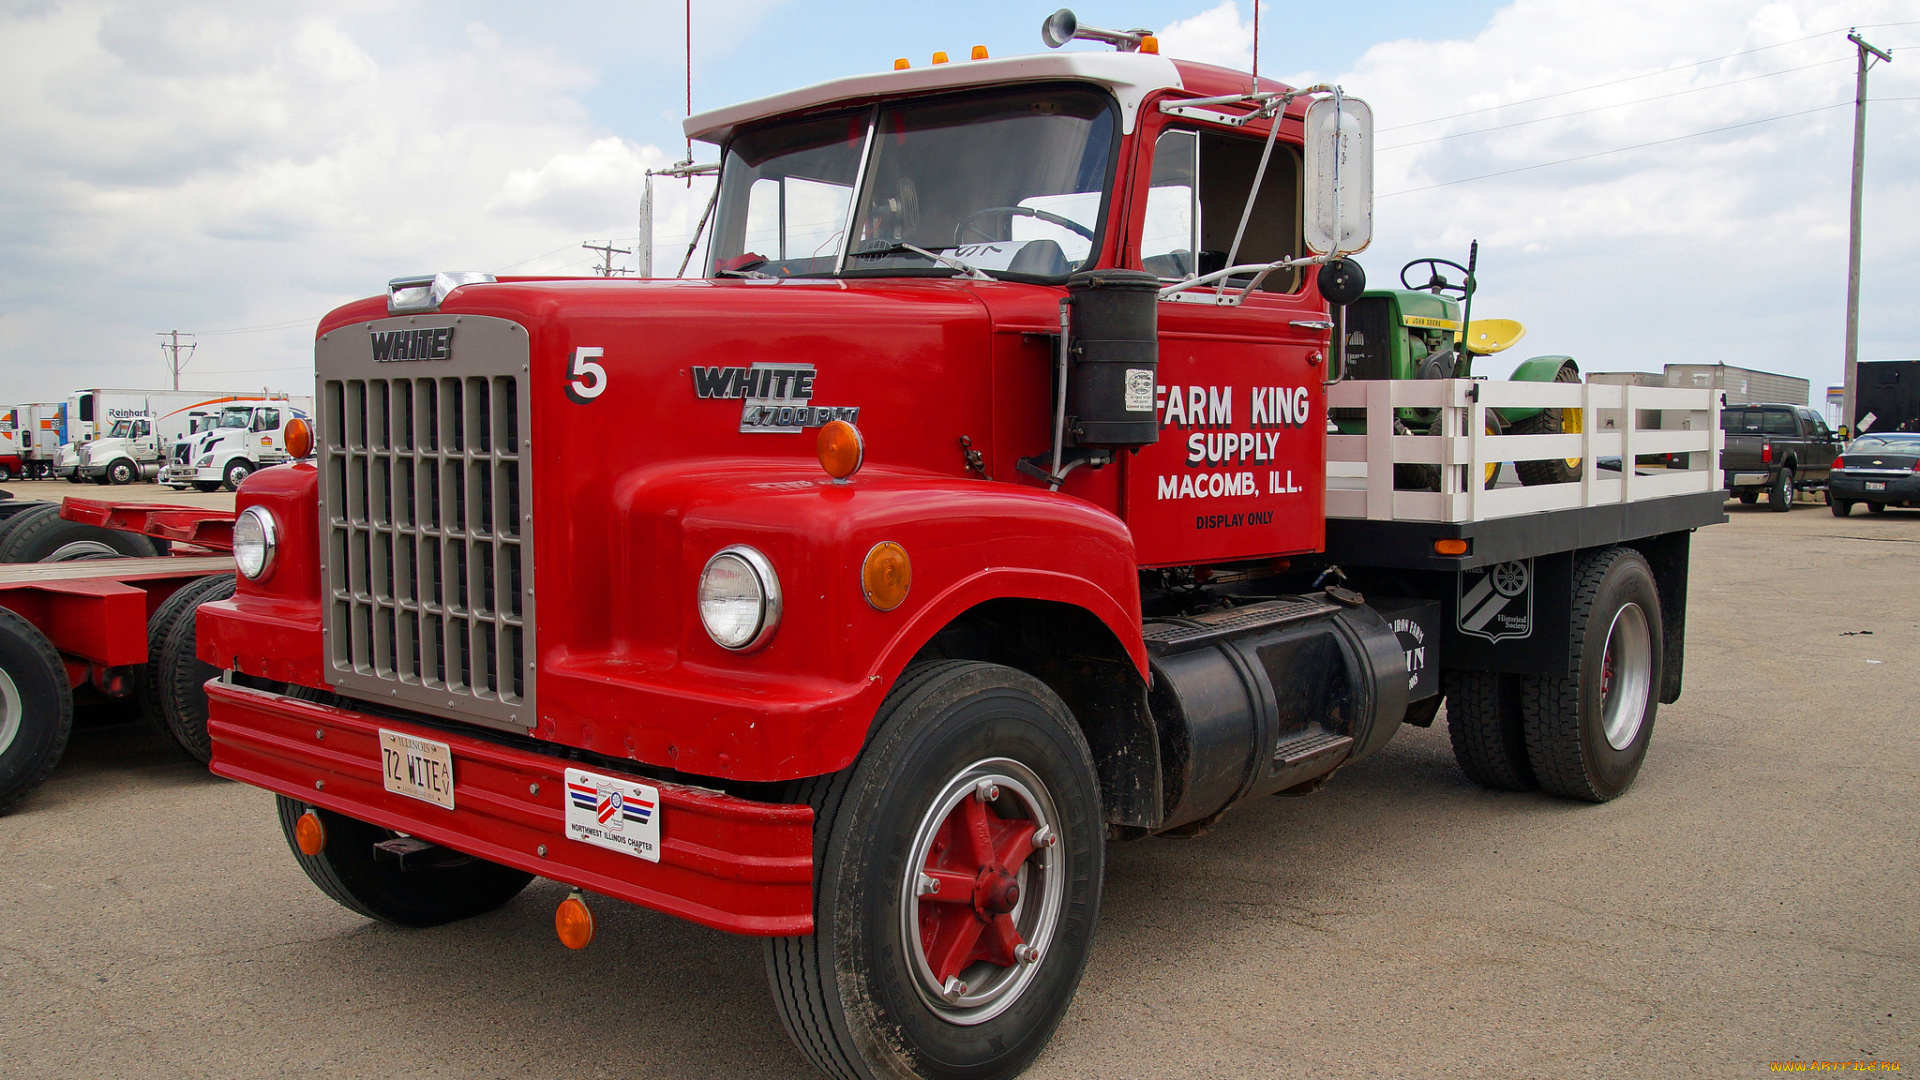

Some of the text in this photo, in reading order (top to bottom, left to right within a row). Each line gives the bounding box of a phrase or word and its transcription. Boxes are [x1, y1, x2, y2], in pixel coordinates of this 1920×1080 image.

[1412, 317, 1441, 327] JOHN DEERE
[370, 327, 455, 363] WHITE
[571, 346, 608, 399] 5
[691, 366, 818, 400] WHITE
[108, 408, 148, 418] Reinhart
[740, 406, 810, 427] 4700
[1157, 385, 1233, 425] FARM
[1251, 386, 1310, 425] KING
[1188, 432, 1281, 462] SUPPLY
[1157, 470, 1303, 500] MACOMB, ILL.
[1196, 511, 1274, 530] DISPLAY ONLY
[1497, 614, 1527, 624] Historical
[1505, 622, 1527, 632] Society
[398, 737, 431, 753] ILLINOIS
[383, 747, 402, 781] 72
[571, 822, 603, 838] NORTHWEST
[604, 831, 627, 845] ILLINOIS
[627, 837, 653, 851] CHAPTER
